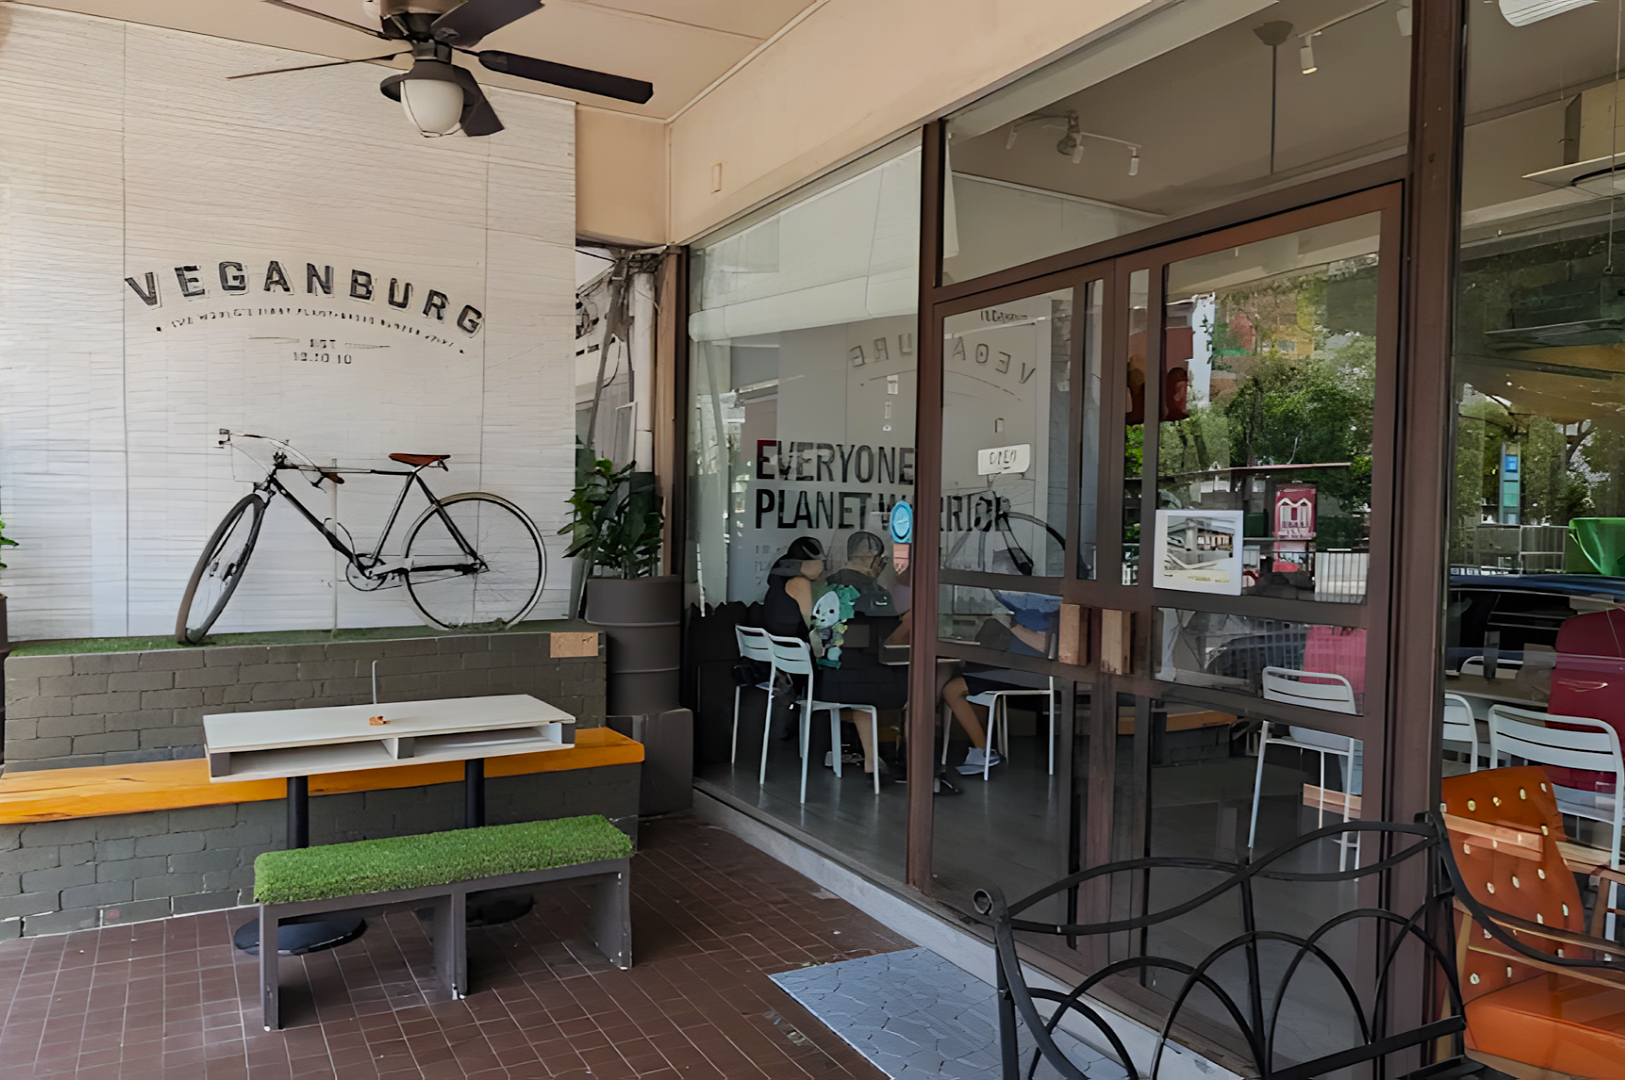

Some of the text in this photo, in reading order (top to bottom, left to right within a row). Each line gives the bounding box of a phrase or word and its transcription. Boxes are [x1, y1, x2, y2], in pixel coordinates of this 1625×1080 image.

[124, 261, 484, 334] VEGANBURG
[756, 439, 914, 485] EVERYONE
[755, 489, 872, 530] PLANET
